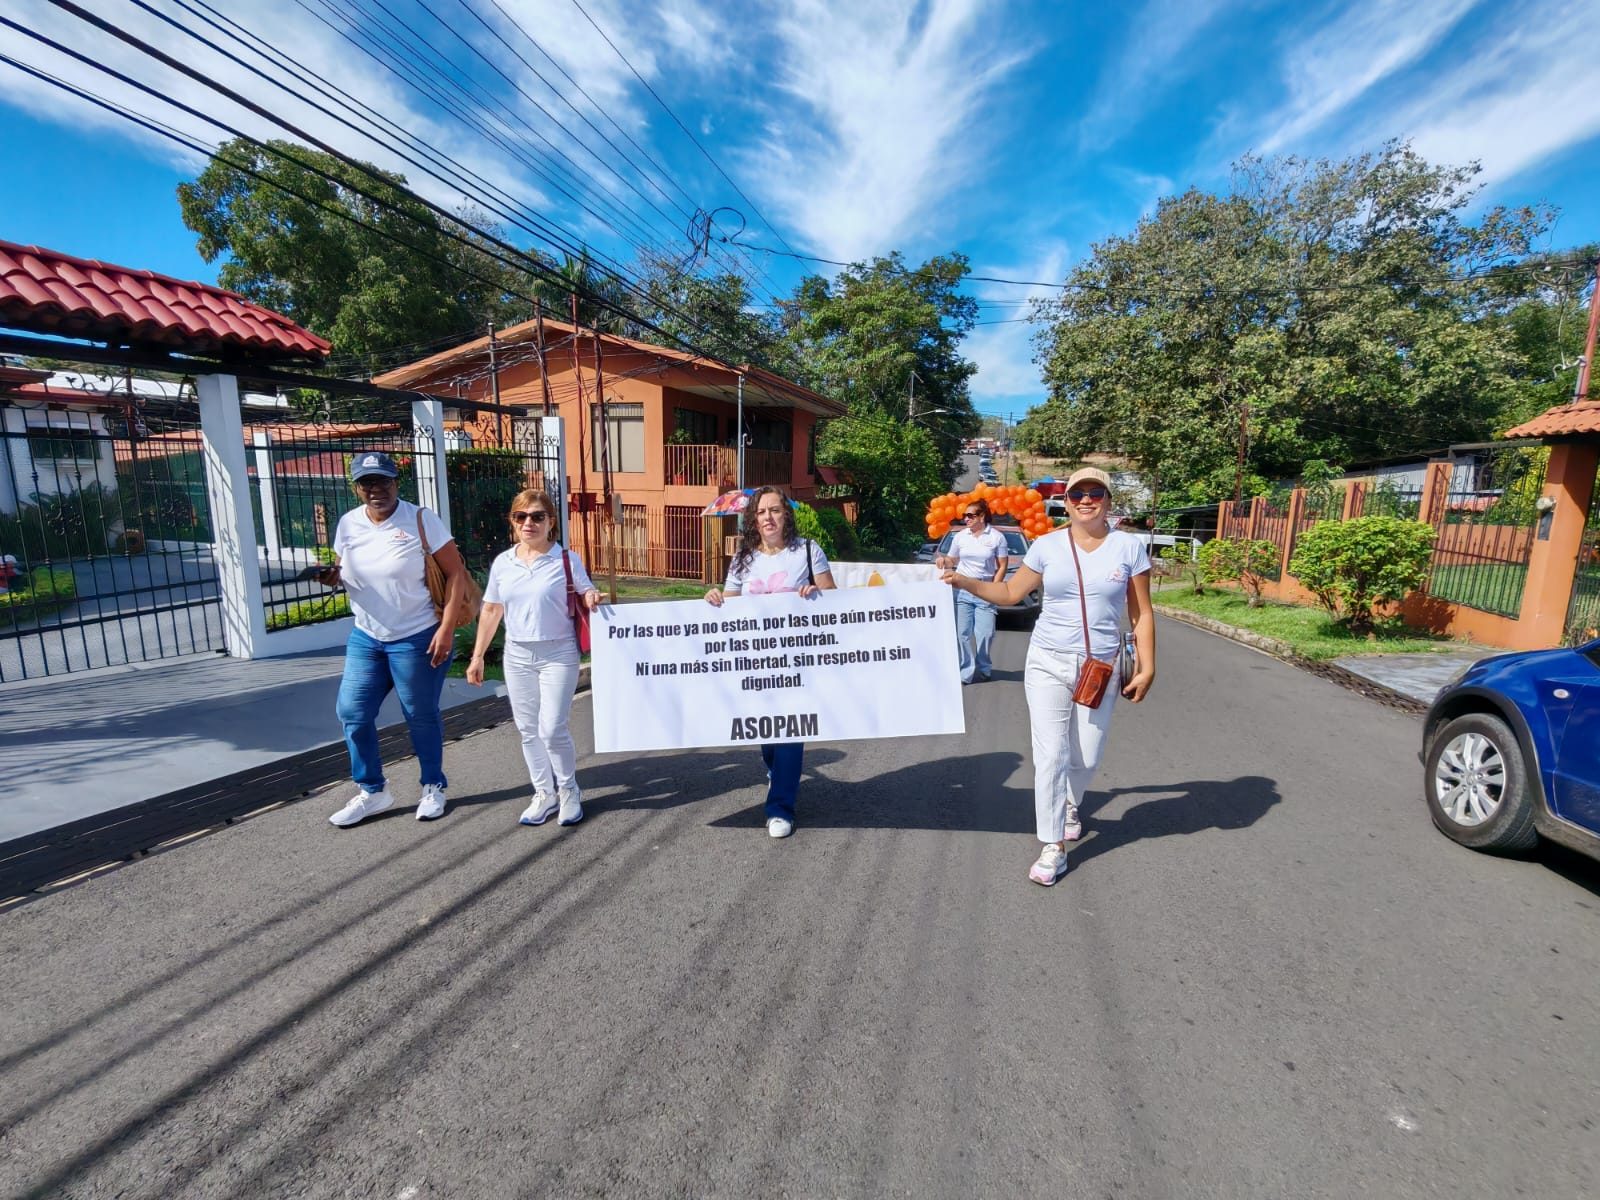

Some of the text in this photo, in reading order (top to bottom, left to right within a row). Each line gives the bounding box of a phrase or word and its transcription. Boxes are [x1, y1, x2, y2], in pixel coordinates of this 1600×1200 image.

[608, 604, 937, 639] Por las que ya no están, por las que aún resisten y
[705, 631, 839, 655] por las que vendrán.
[635, 645, 911, 676] Ni una más sin libertad, sin respeto ni sin
[741, 673, 805, 691] dignidad.
[730, 713, 819, 741] ASOPAM
